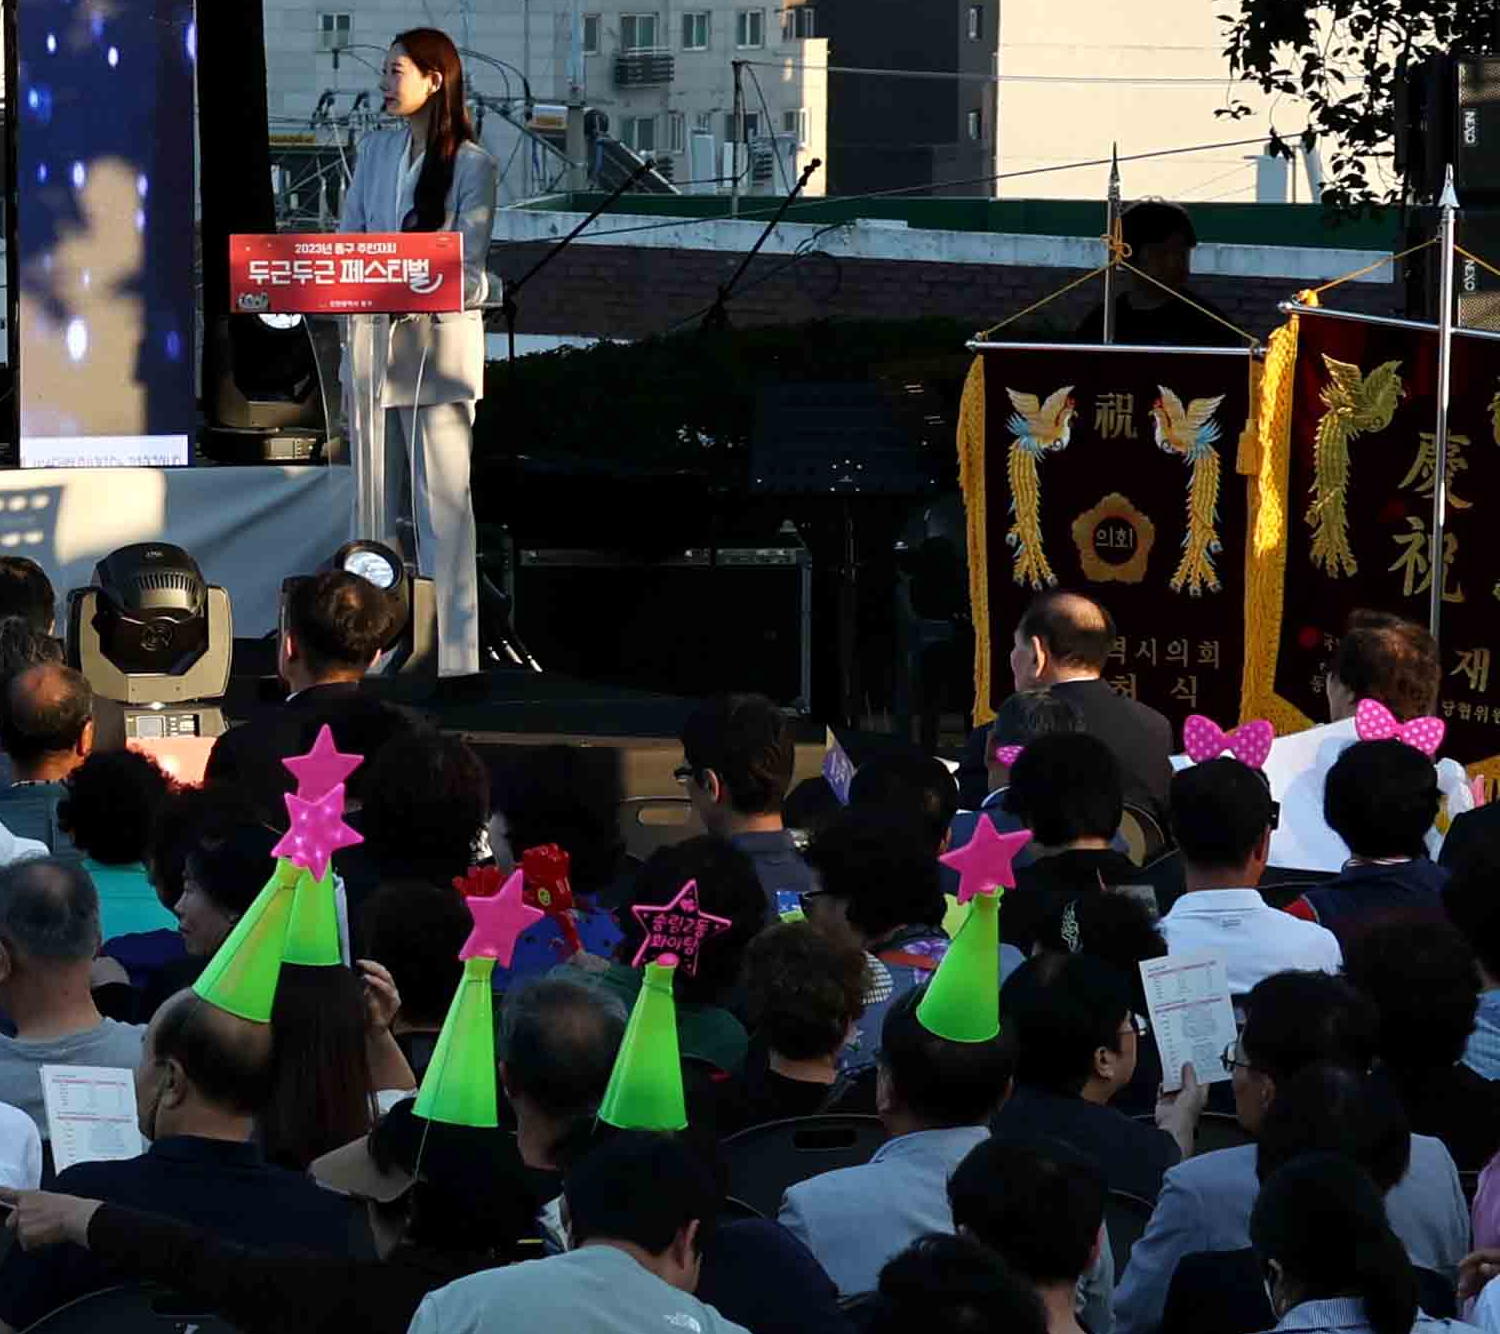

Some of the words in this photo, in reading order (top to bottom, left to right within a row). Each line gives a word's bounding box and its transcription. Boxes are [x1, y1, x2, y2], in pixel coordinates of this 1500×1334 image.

[1464, 110, 1476, 144] NEXO
[295, 243, 333, 254] 2023년
[249, 259, 336, 284] 두근두근
[339, 258, 443, 294] 페스티벌
[1464, 259, 1476, 292] NEXO
[1093, 391, 1138, 440] 祝
[1095, 525, 1135, 549] 의회
[1170, 673, 1197, 708] 식
